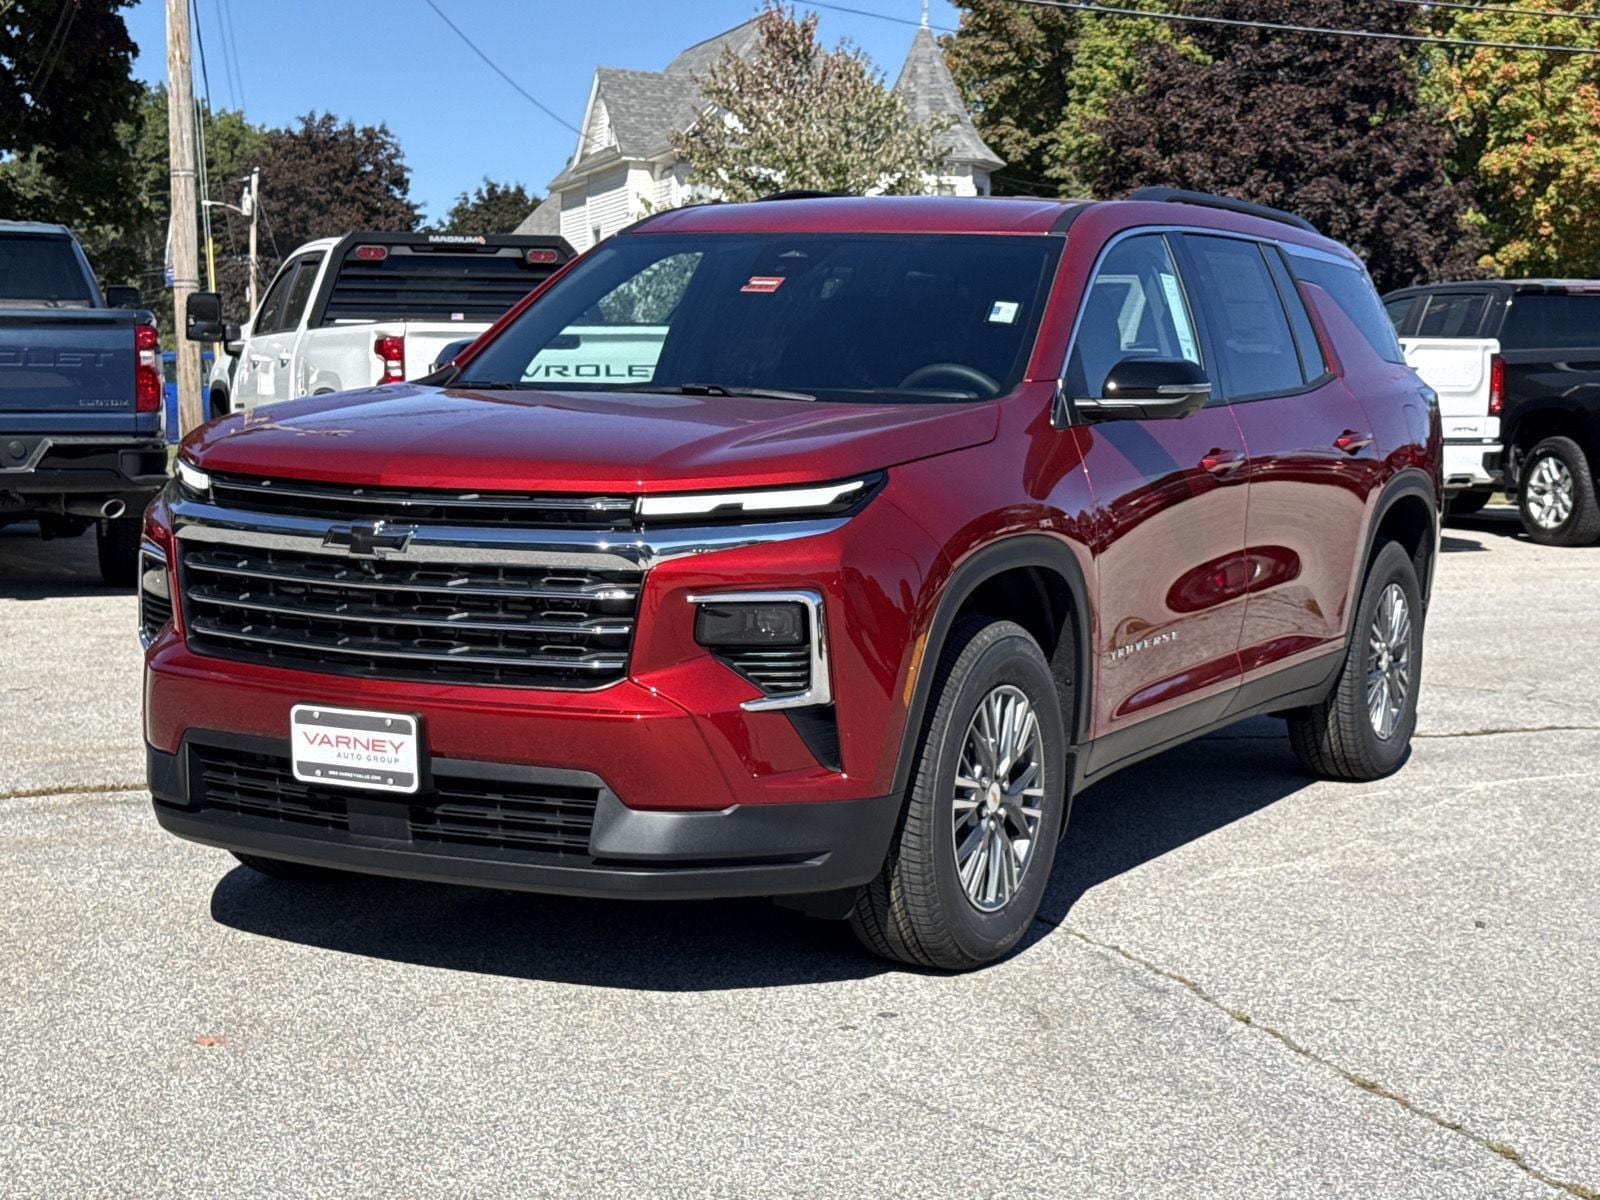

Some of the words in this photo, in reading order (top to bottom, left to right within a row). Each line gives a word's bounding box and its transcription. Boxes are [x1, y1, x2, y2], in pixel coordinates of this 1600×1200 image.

[428, 235, 481, 243] MAGNUM
[303, 731, 405, 754] VARNEY
[336, 751, 362, 761] AUTO
[366, 755, 400, 765] GROUP
